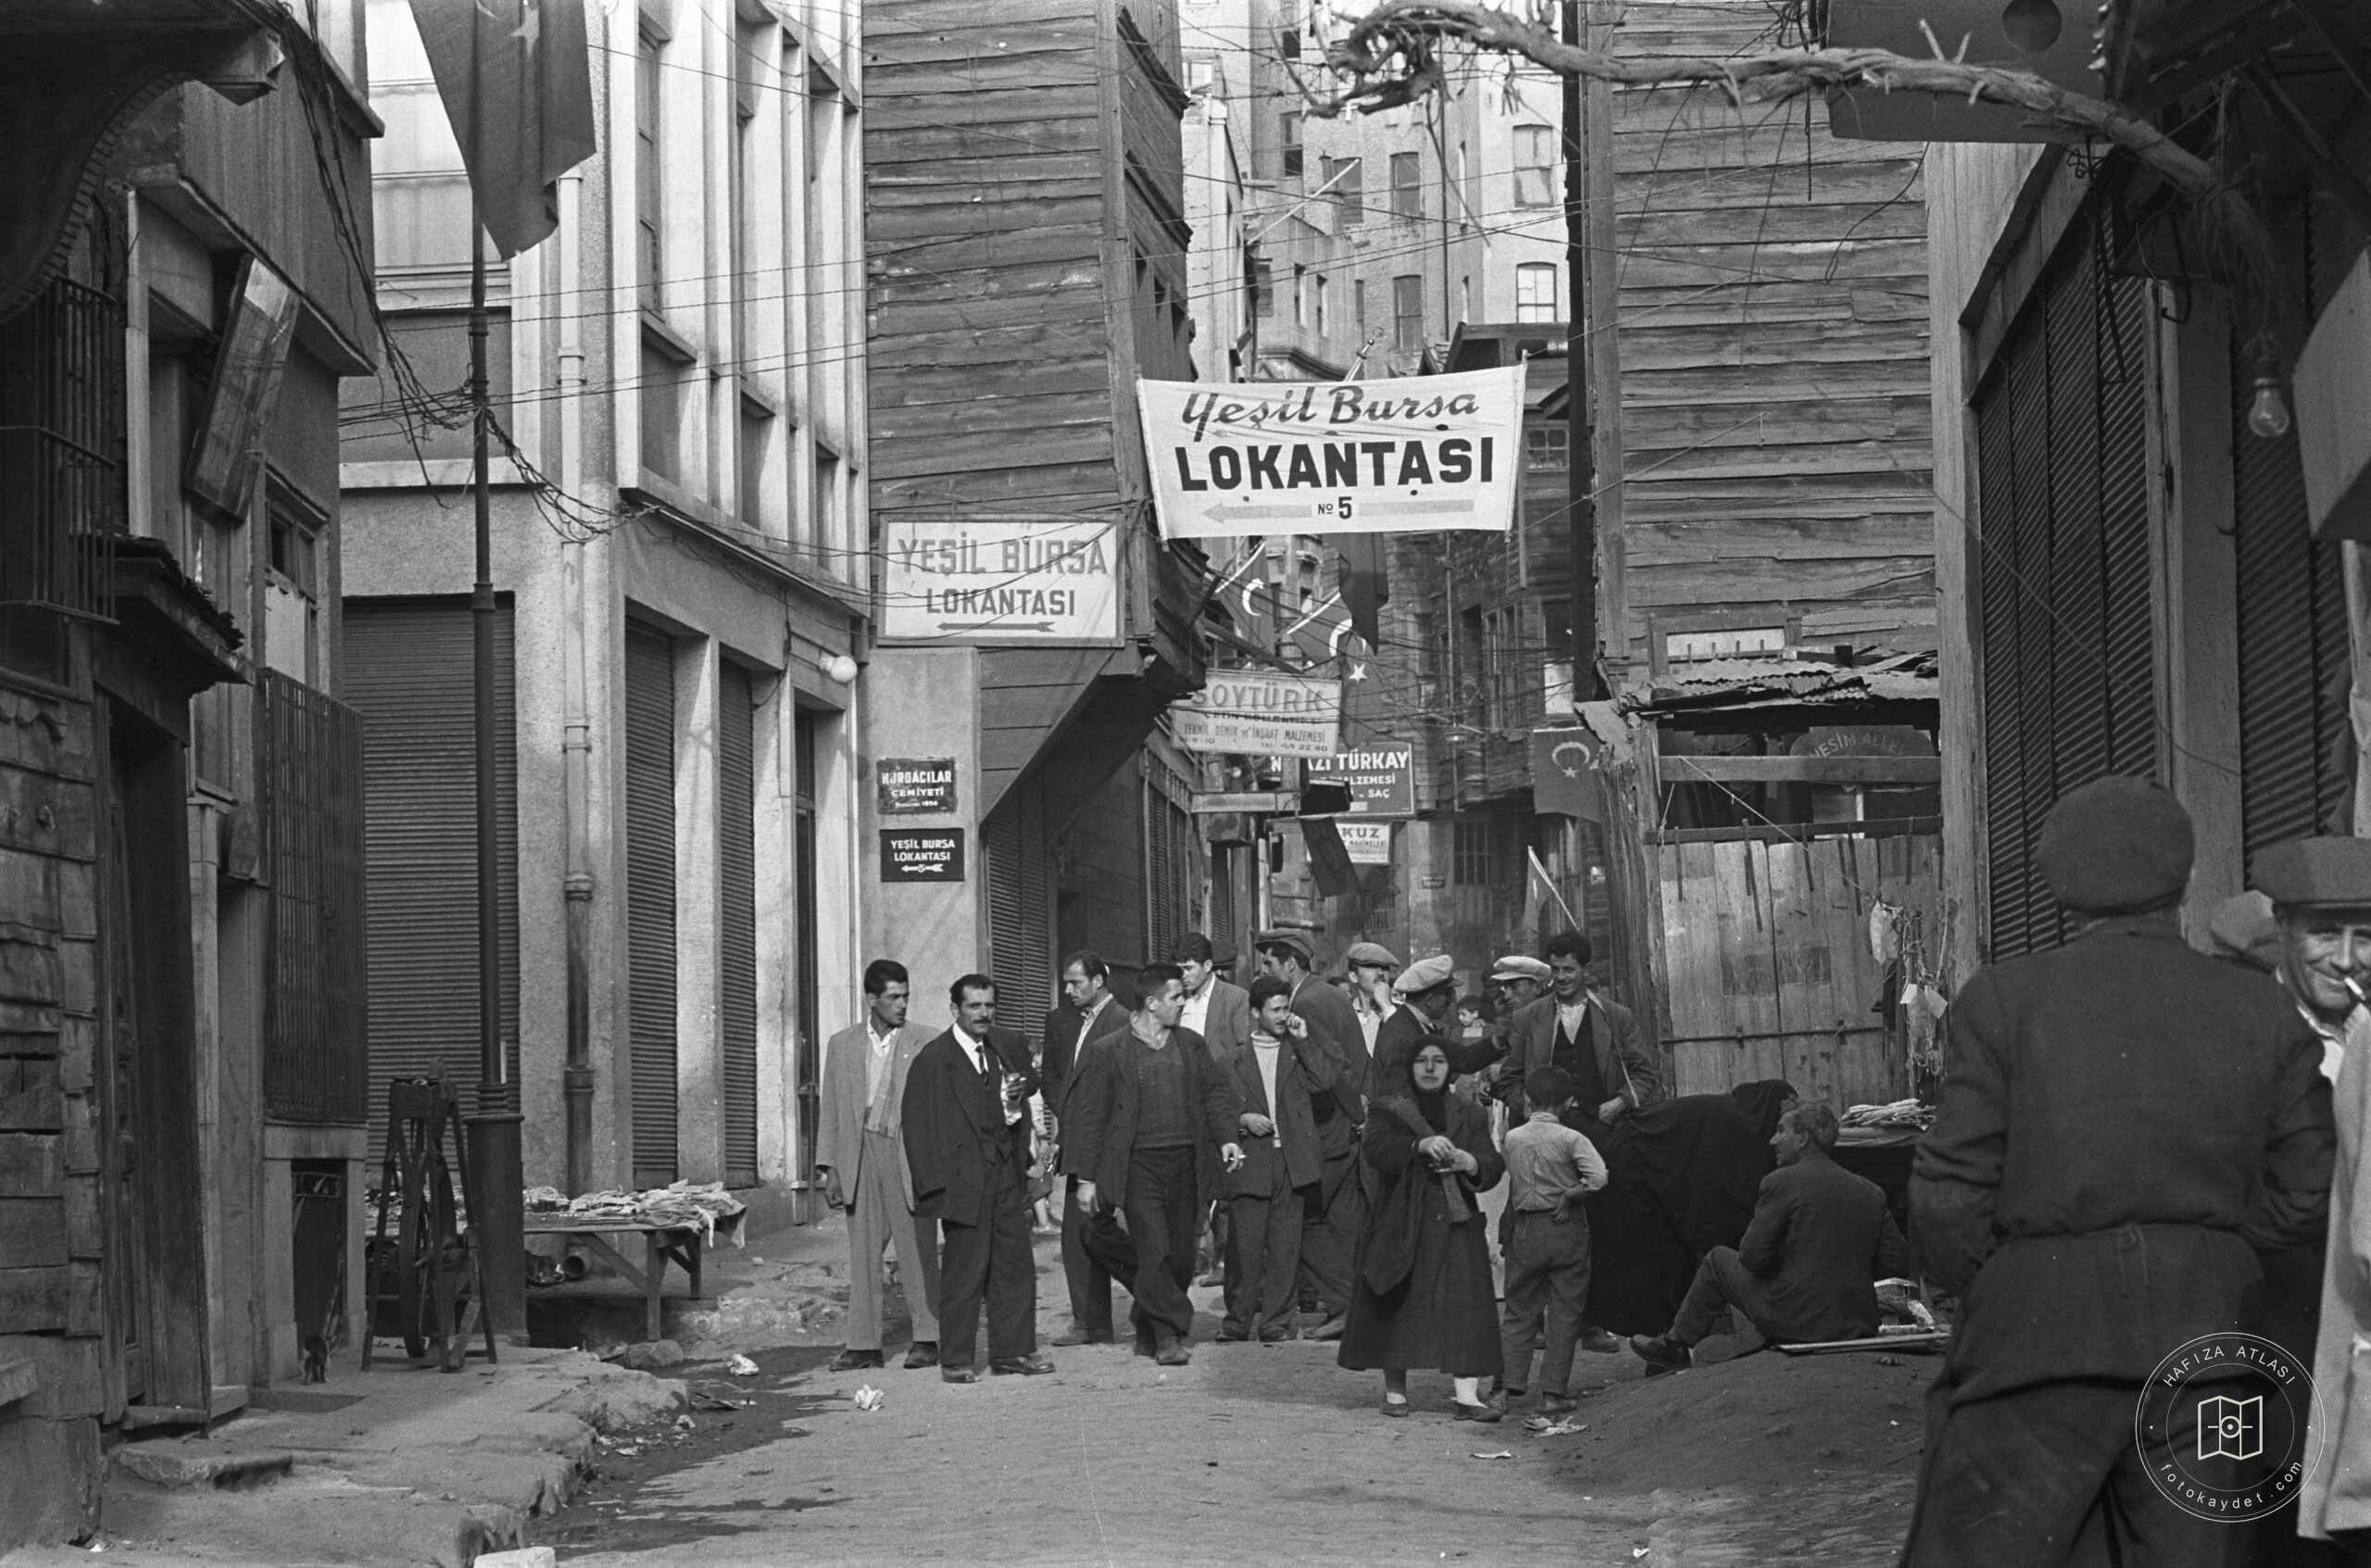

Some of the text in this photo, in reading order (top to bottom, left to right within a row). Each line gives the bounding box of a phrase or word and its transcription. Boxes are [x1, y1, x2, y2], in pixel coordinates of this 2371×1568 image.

[1182, 385, 1479, 443] Yeşil Bursa
[1174, 436, 1494, 492] LOKANTASI
[1337, 496, 1352, 520] 5
[1001, 539, 1108, 574] BURSA
[927, 588, 1075, 616] LOKANTASI
[1285, 730, 1326, 743] MALZEMESİ
[1336, 748, 1409, 771] TÜRKAY
[892, 786, 944, 797] CEMİYETİ
[1368, 788, 1391, 798] SAÇ
[890, 838, 956, 850] YEŞİL BURSA
[894, 851, 950, 861] LOKANTASI
[918, 863, 925, 872] 5
